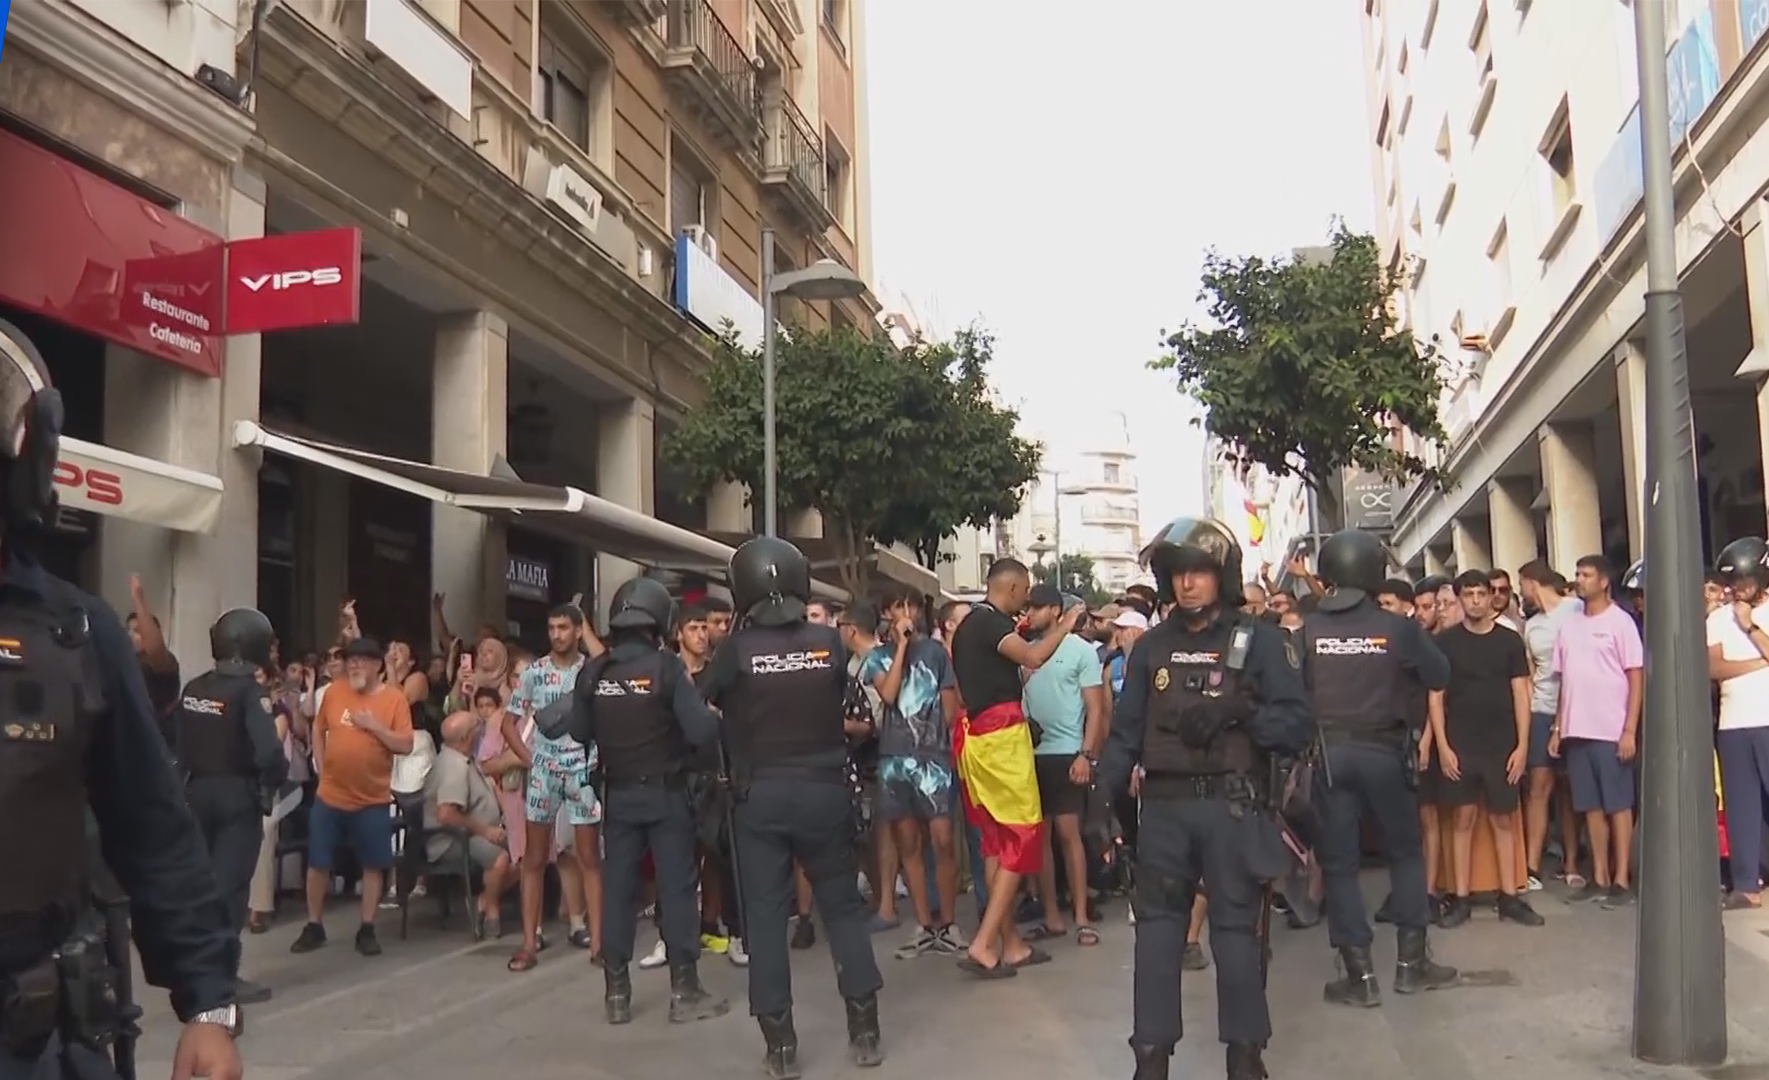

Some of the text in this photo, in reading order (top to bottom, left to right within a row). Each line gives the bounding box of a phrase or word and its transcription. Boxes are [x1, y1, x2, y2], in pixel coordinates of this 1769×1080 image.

[240, 266, 341, 292] VIPS
[142, 291, 210, 331] Restaurante
[506, 559, 548, 588] A MAFIA
[752, 651, 814, 665] POLICIA
[1315, 645, 1387, 654] NACIONAL
[752, 659, 831, 674] NACIONAL
